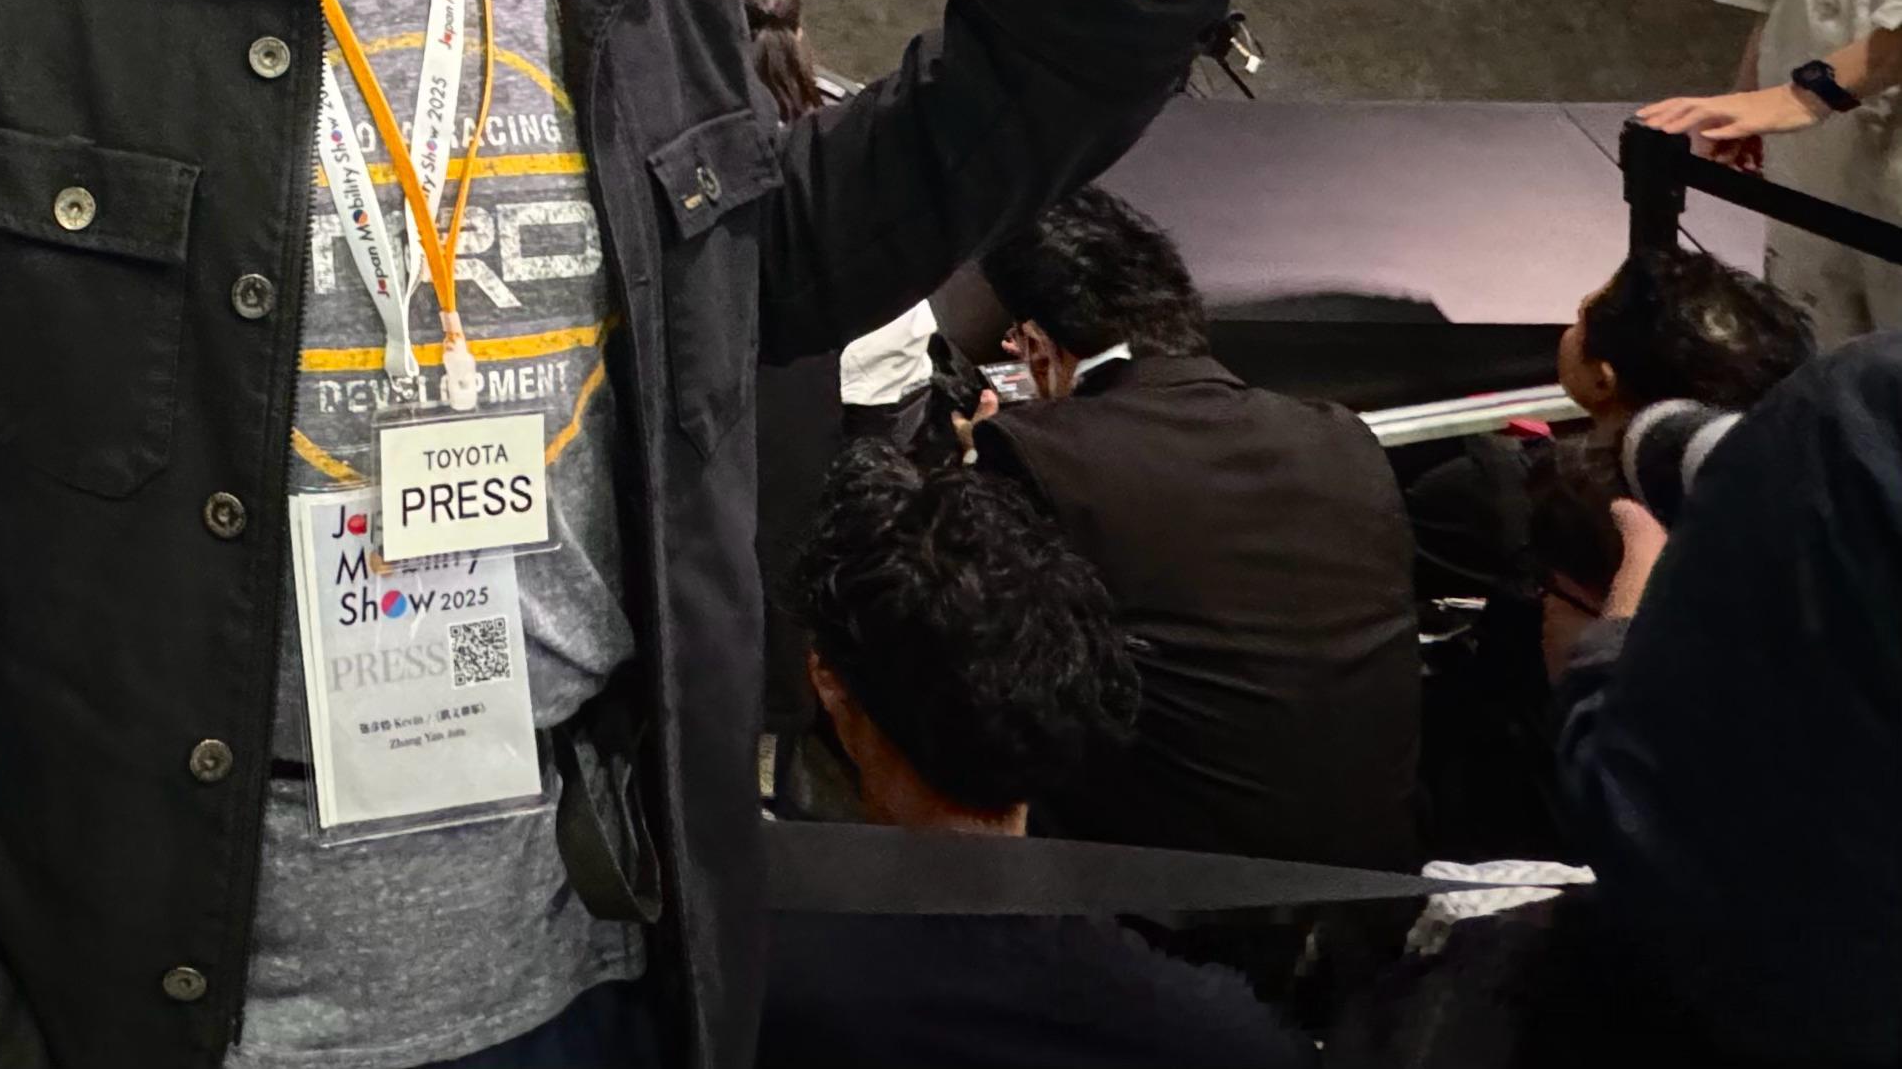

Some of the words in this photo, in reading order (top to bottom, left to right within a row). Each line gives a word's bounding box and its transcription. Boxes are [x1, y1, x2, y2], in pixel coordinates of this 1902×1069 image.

[426, 75, 448, 123] 2025
[327, 116, 351, 163] Show
[341, 166, 375, 242] Mobility
[367, 245, 391, 299] Japan
[318, 360, 570, 413] DEVLPMENT
[423, 443, 509, 471] TOYOTA
[401, 474, 533, 527] PRESS
[338, 585, 436, 626] Show
[440, 586, 489, 611] 2025
[331, 642, 448, 693] PRESS
